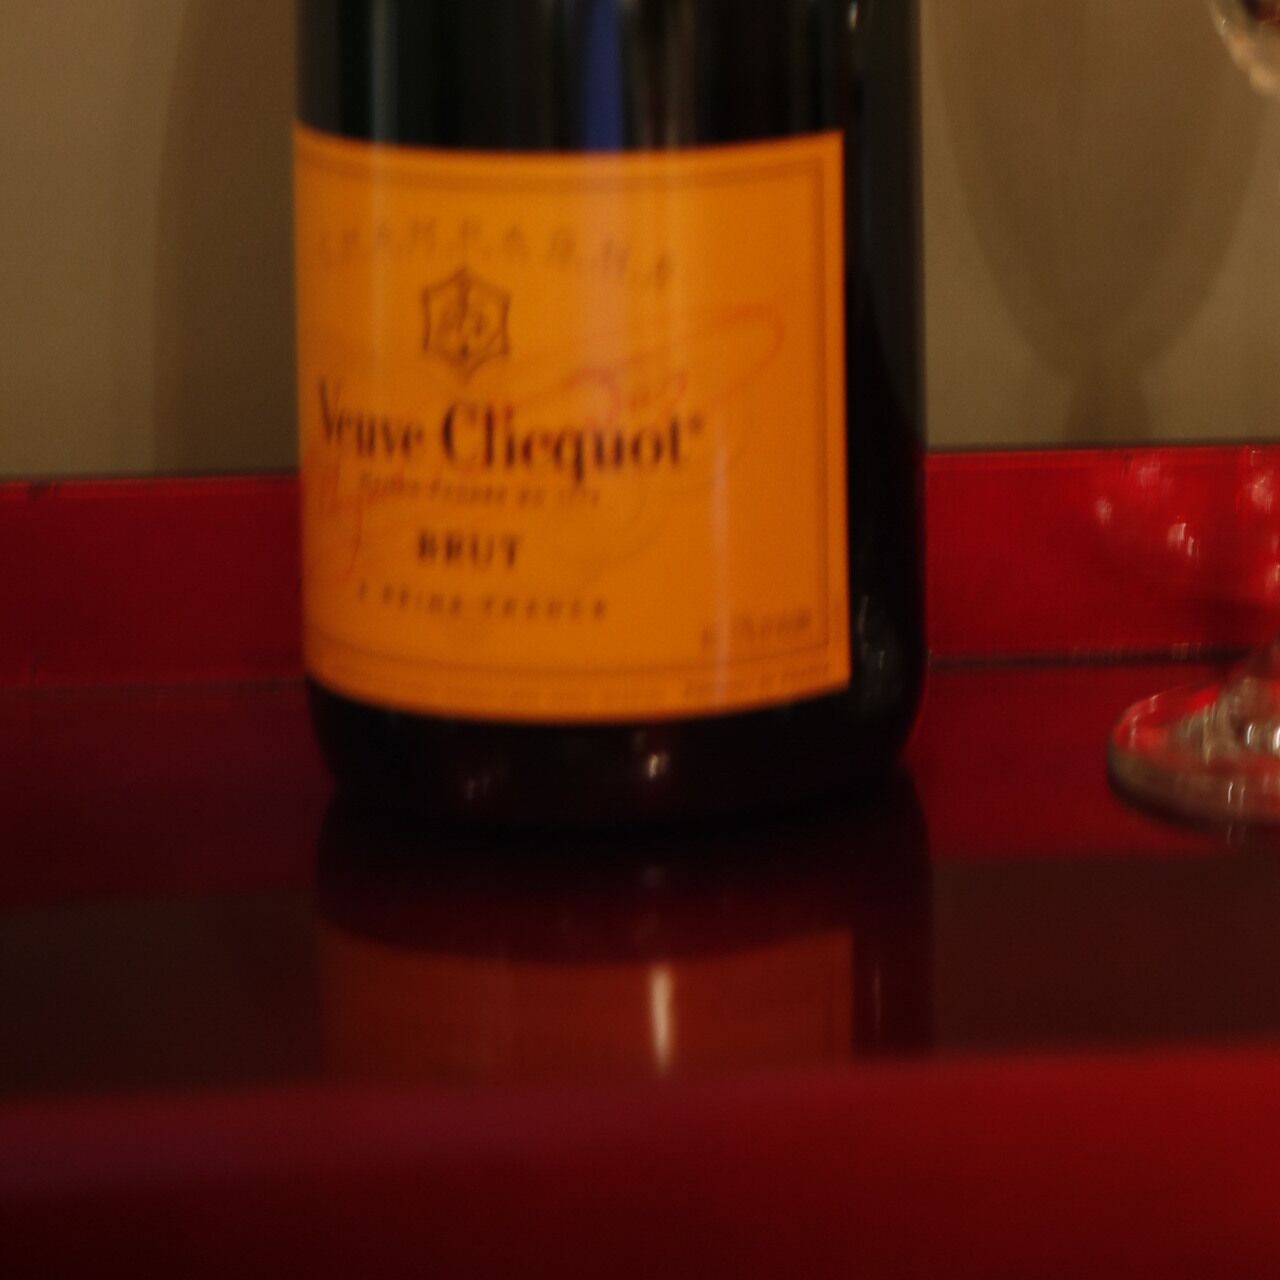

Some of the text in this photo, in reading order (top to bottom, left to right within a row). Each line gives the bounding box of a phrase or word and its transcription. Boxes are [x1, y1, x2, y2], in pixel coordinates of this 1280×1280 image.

[317, 375, 428, 461] Veuve
[441, 399, 684, 489] Clicquot
[416, 530, 523, 570] BRUT
